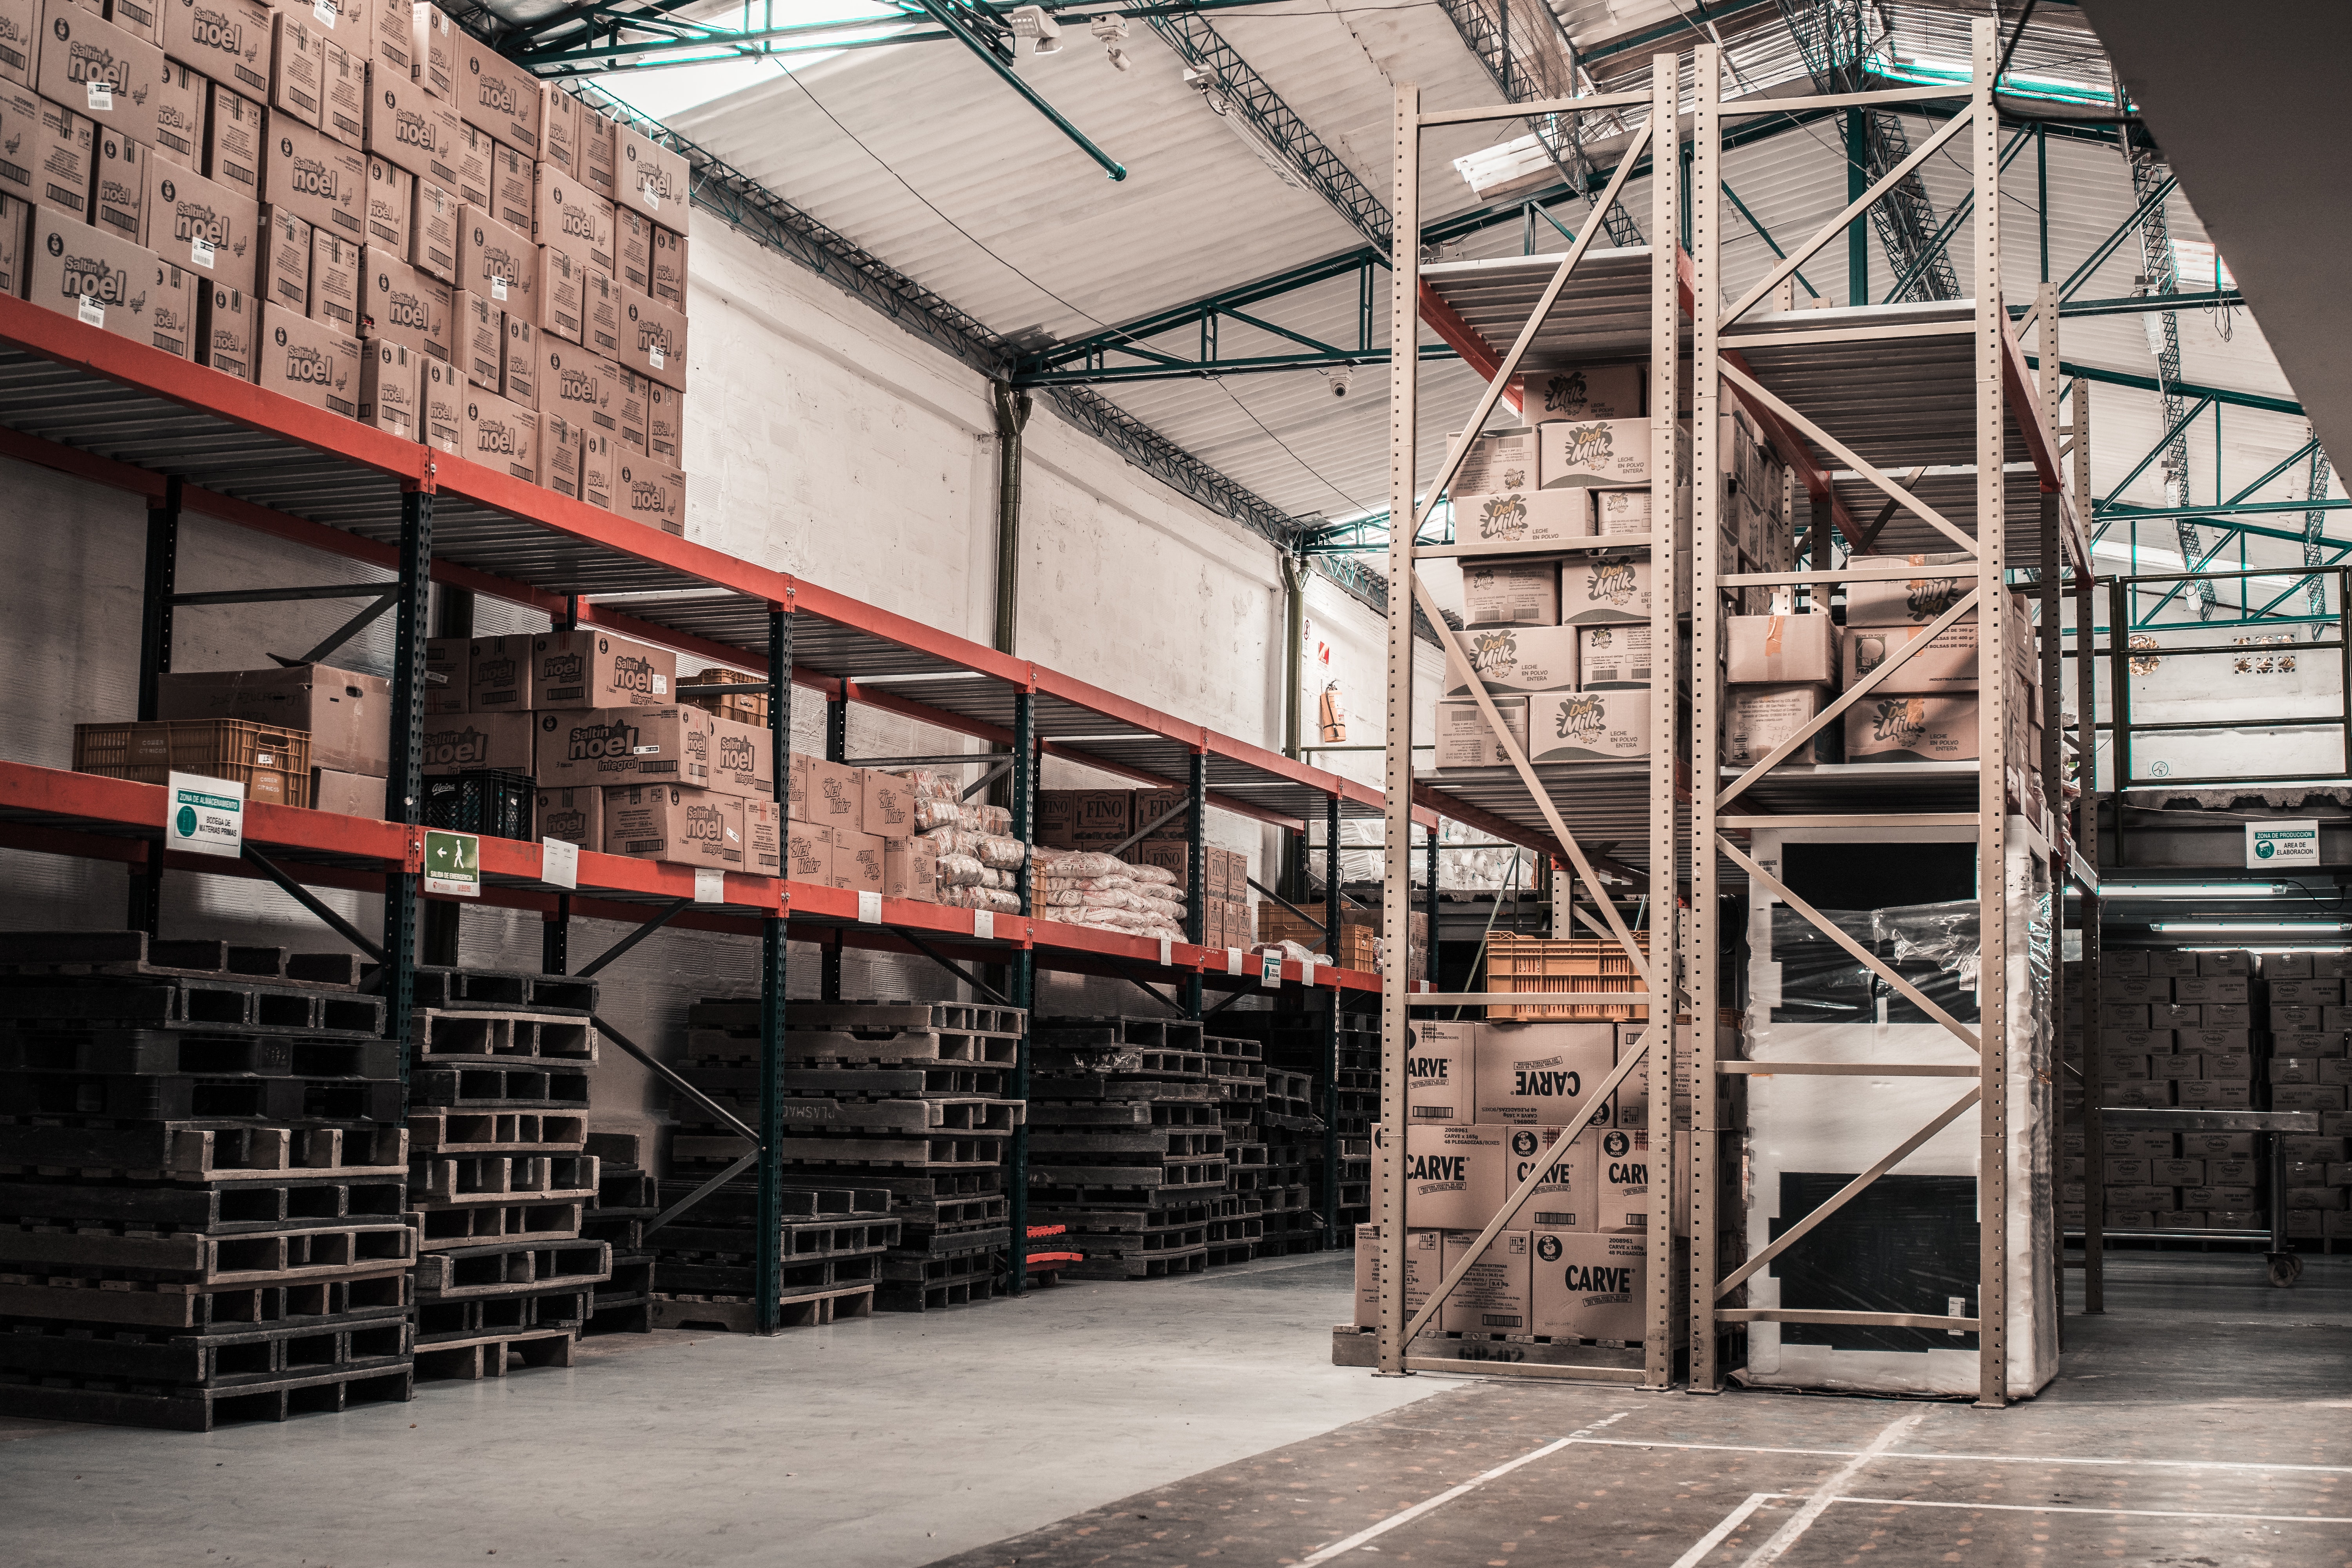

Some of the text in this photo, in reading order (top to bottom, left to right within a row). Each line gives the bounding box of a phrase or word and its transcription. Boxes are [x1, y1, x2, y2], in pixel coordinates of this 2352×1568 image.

[193, 18, 242, 55] noel
[67, 56, 129, 96] noel
[479, 84, 516, 115] noel
[396, 119, 436, 152] noel
[292, 167, 338, 200] noel
[101, 187, 130, 205] noel
[175, 213, 230, 250] noel
[562, 214, 595, 241] noel
[483, 256, 519, 288] noel
[62, 269, 127, 307] noel
[390, 302, 428, 331] noel
[286, 356, 332, 386] noel
[561, 377, 597, 404] noel
[1557, 377, 1576, 392] Deli
[1550, 388, 1584, 407] Milk
[477, 427, 515, 455] noel
[1579, 428, 1602, 445] Deli
[1571, 438, 1608, 462] Milk
[632, 488, 665, 512] noel
[1493, 500, 1515, 517] Deli
[1486, 510, 1523, 534] Milk
[1601, 564, 1623, 579] Deli
[1593, 572, 1631, 597] Milk
[1483, 635, 1505, 652] Deli
[1476, 645, 1513, 669] Milk
[614, 667, 654, 694] noel
[630, 693, 654, 704] Integral
[1569, 701, 1592, 716] Deli
[1562, 711, 1601, 735] Milk
[422, 734, 488, 764] noel
[568, 727, 639, 760] noel
[598, 757, 639, 772] Integral
[720, 745, 755, 772] noel
[432, 783, 456, 793] Alpina
[735, 772, 754, 785] Integral
[824, 782, 842, 797] Jet
[200, 797, 238, 809] ALMACENAMIENTO
[830, 798, 851, 814] Wafer
[880, 792, 896, 808] Jet
[1042, 800, 1068, 813] FINO
[1086, 800, 1122, 818] FINO
[207, 816, 224, 826] BODEGA
[885, 808, 905, 824] Wafer
[199, 824, 237, 837] MATERIAS PRIMAS
[686, 814, 723, 842] noel
[702, 842, 723, 855] Integral
[791, 841, 811, 858] Jet
[1153, 852, 1180, 865] FINO
[797, 857, 820, 874] Wafer
[1212, 859, 1225, 878] FINO
[1233, 864, 1245, 882] FINO
[1409, 1058, 1448, 1078] ARVE
[1515, 1071, 1581, 1097] CARVE
[1407, 1154, 1465, 1180] CARVE
[1609, 1163, 1648, 1184] CARV
[1565, 1265, 1630, 1293] CARVE
